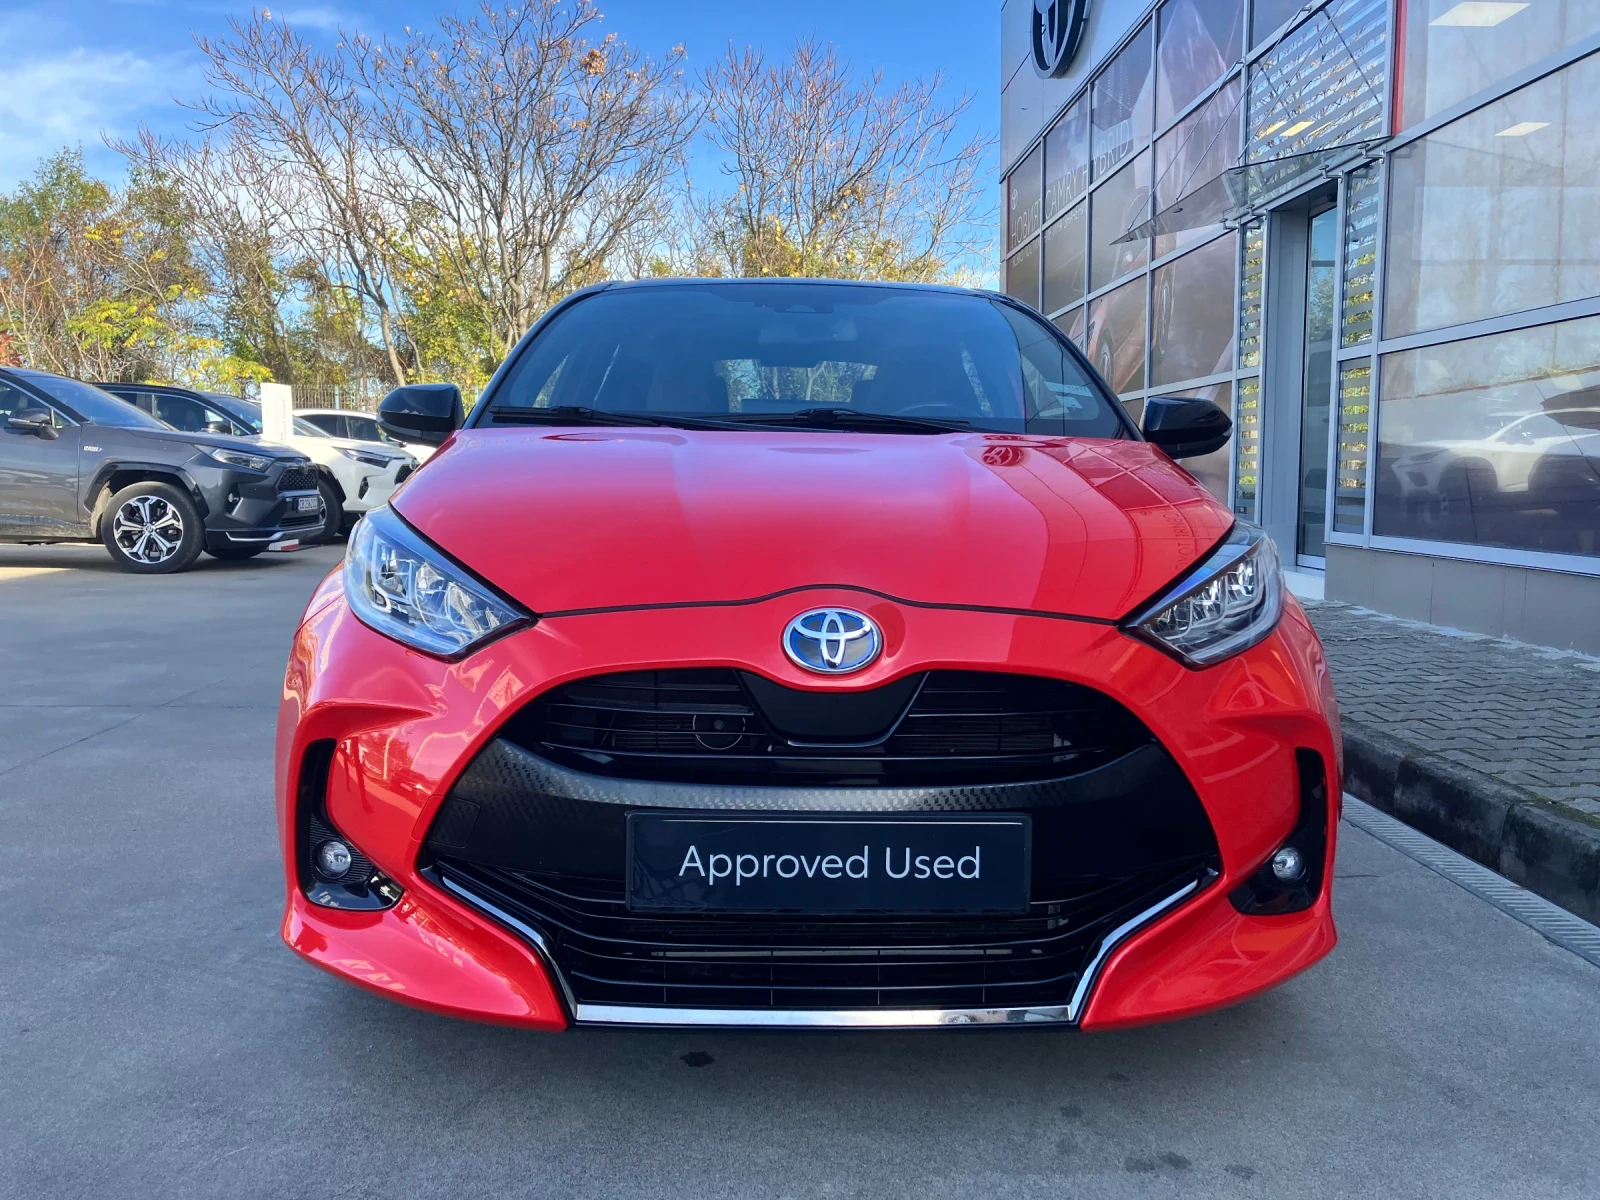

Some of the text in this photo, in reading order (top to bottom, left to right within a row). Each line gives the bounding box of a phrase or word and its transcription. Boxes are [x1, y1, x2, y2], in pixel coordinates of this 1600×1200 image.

[1045, 167, 1078, 219] CAMRY
[1081, 119, 1130, 189] HYBRID
[678, 845, 980, 886] Approved Used
